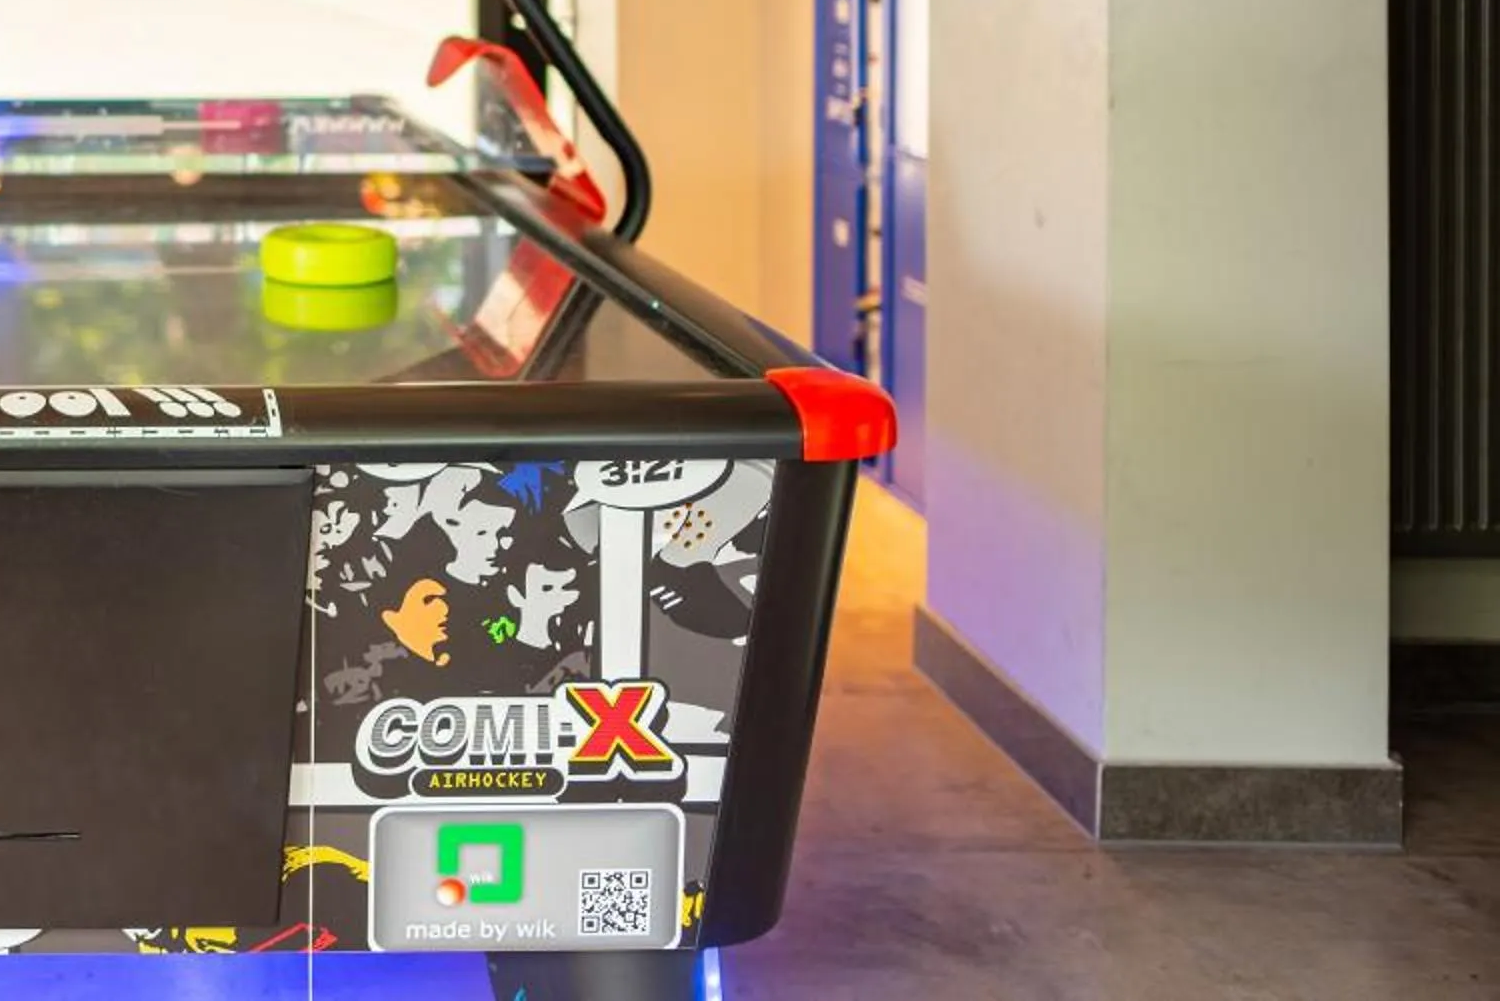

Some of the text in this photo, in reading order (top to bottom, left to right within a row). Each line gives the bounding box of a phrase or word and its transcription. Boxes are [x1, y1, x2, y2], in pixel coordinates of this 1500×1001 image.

[367, 685, 674, 775] COMI-X
[428, 771, 548, 788] AIRHOCKEY
[406, 918, 556, 942] made by wik
